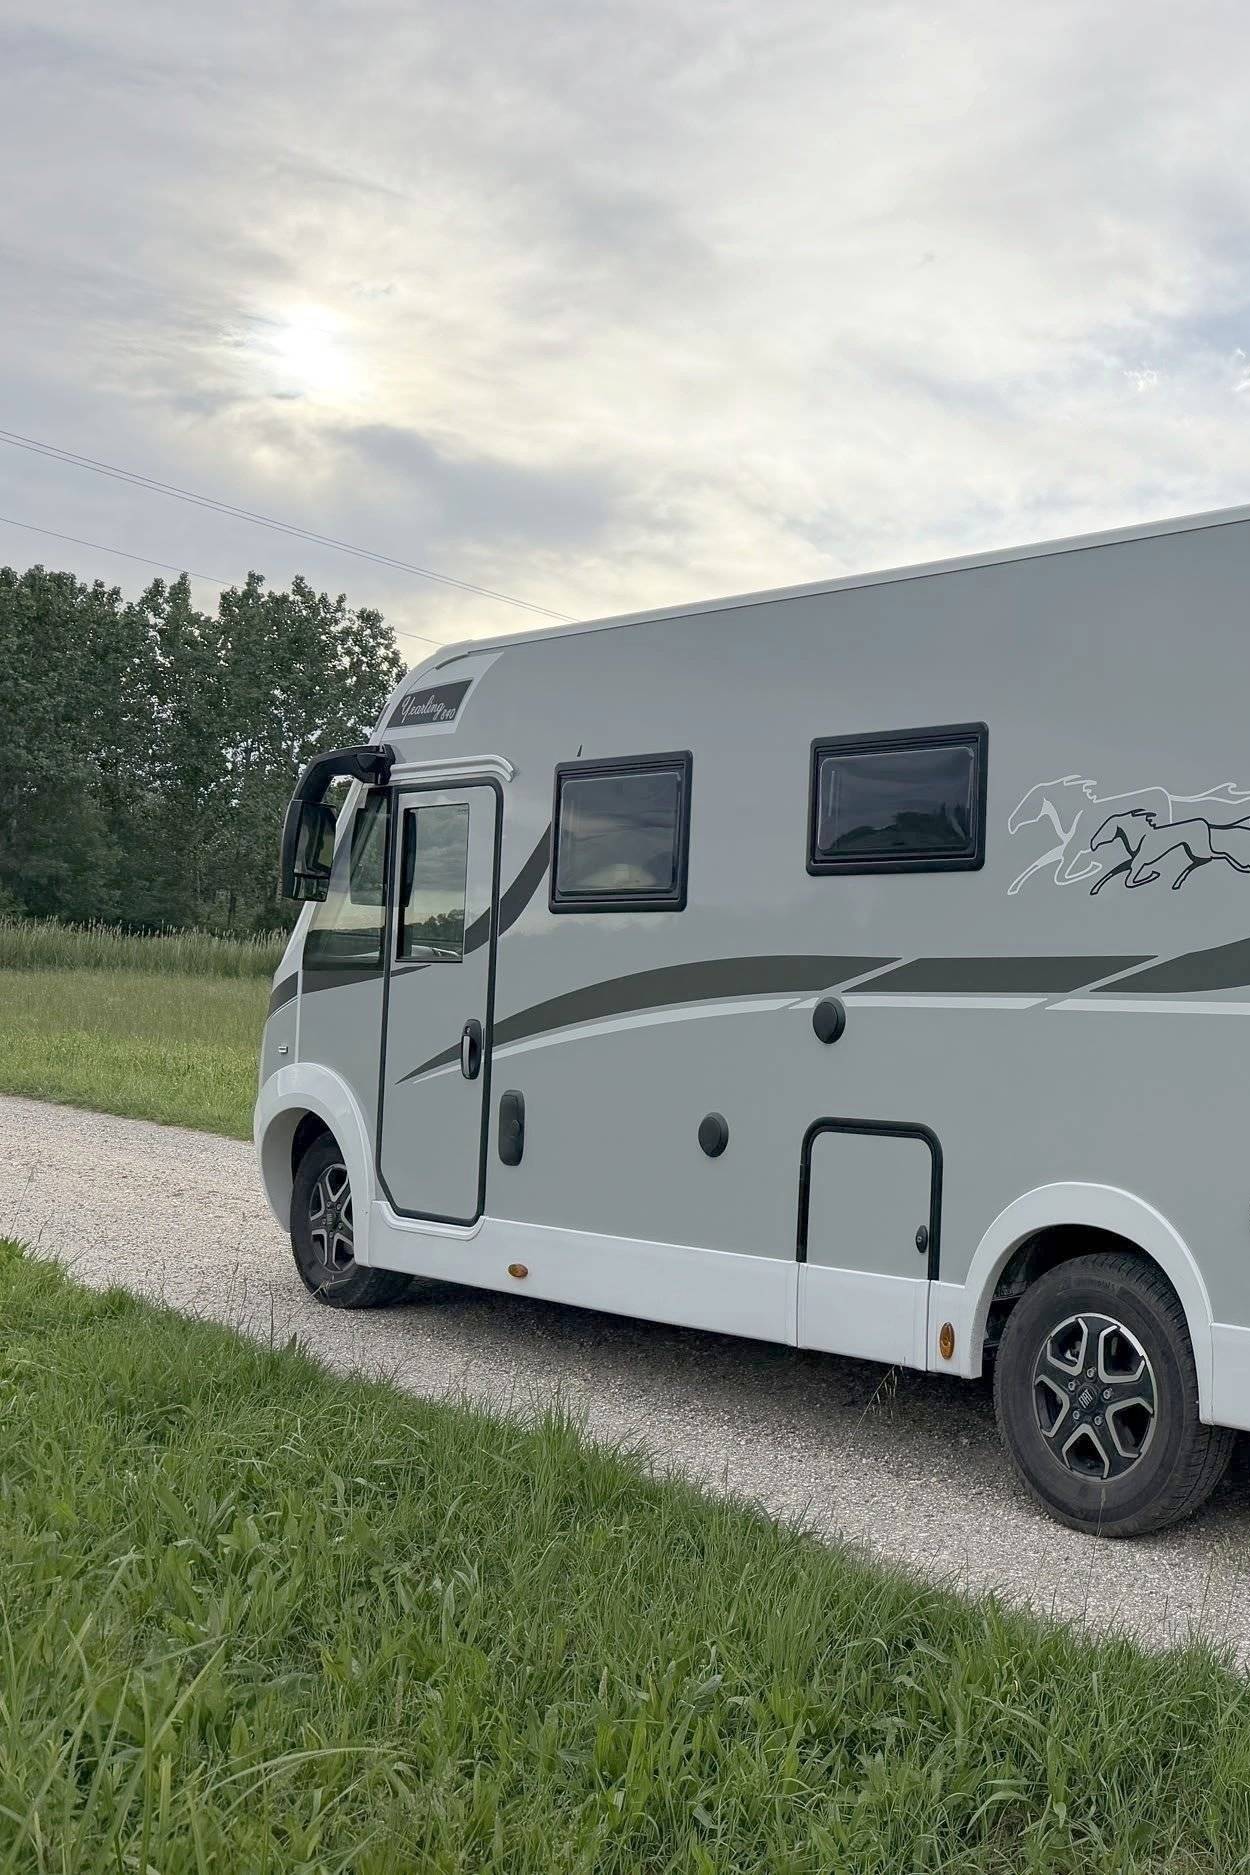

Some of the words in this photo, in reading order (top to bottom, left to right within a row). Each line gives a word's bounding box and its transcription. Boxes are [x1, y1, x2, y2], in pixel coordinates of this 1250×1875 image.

[401, 695, 445, 723] Yearling
[440, 708, 456, 720] 840
[1079, 1389, 1093, 1409] FIAT
